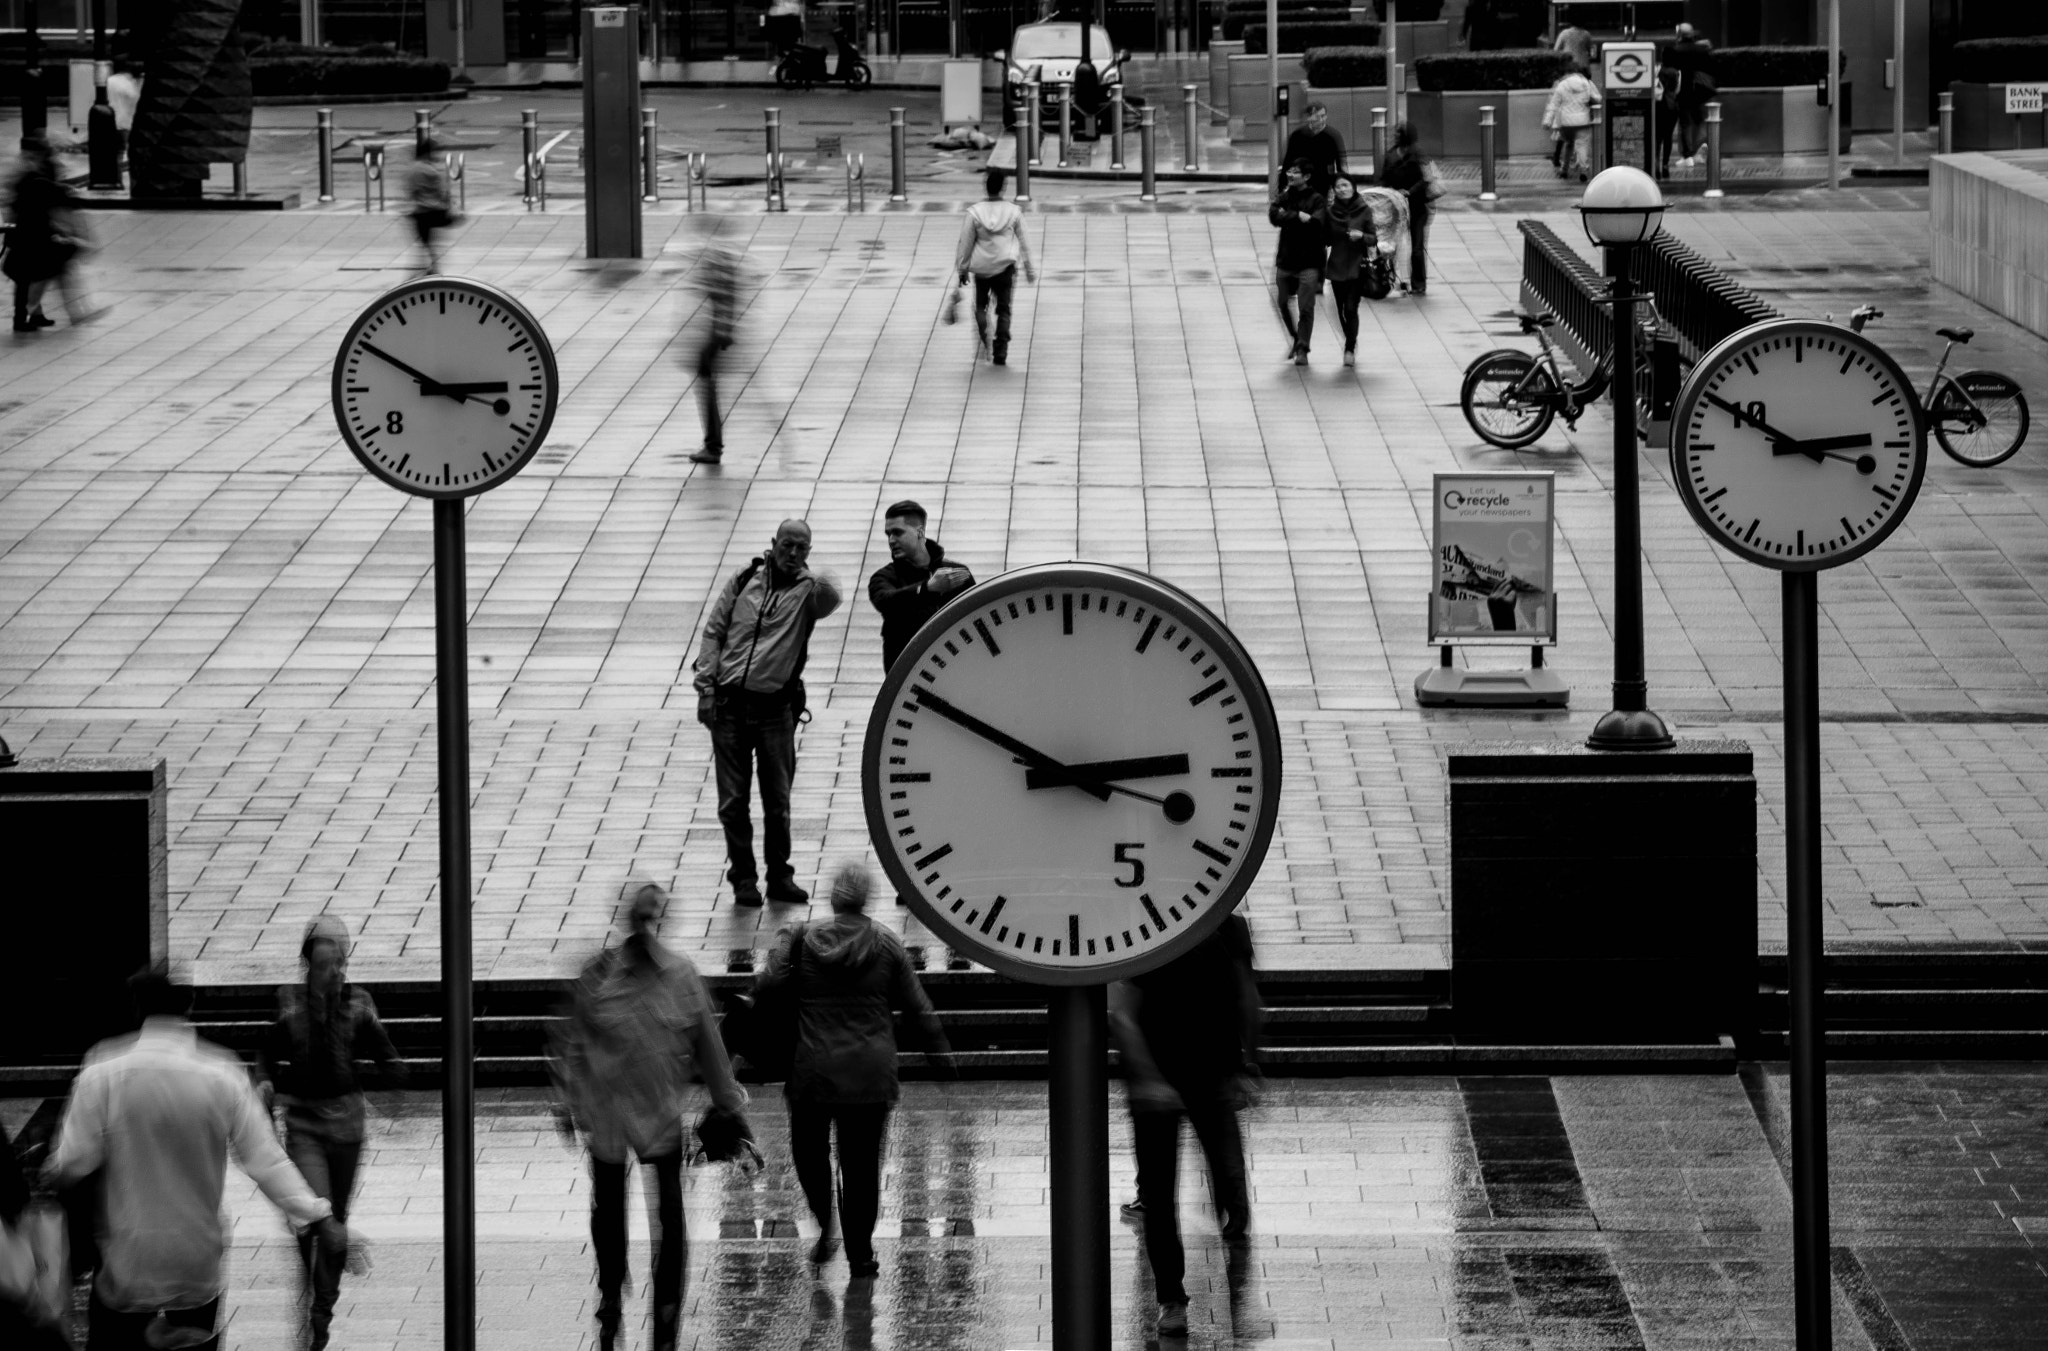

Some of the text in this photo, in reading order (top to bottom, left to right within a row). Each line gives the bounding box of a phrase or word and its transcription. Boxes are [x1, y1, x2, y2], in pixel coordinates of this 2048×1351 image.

[2010, 87, 2040, 97] BANK
[2010, 99, 2041, 109] STREE
[1494, 368, 1525, 376] Santander
[1974, 384, 2006, 392] Santander
[1733, 400, 1766, 429] 10
[386, 410, 404, 435] 8
[1467, 494, 1510, 509] recycle
[1113, 842, 1146, 888] 5
